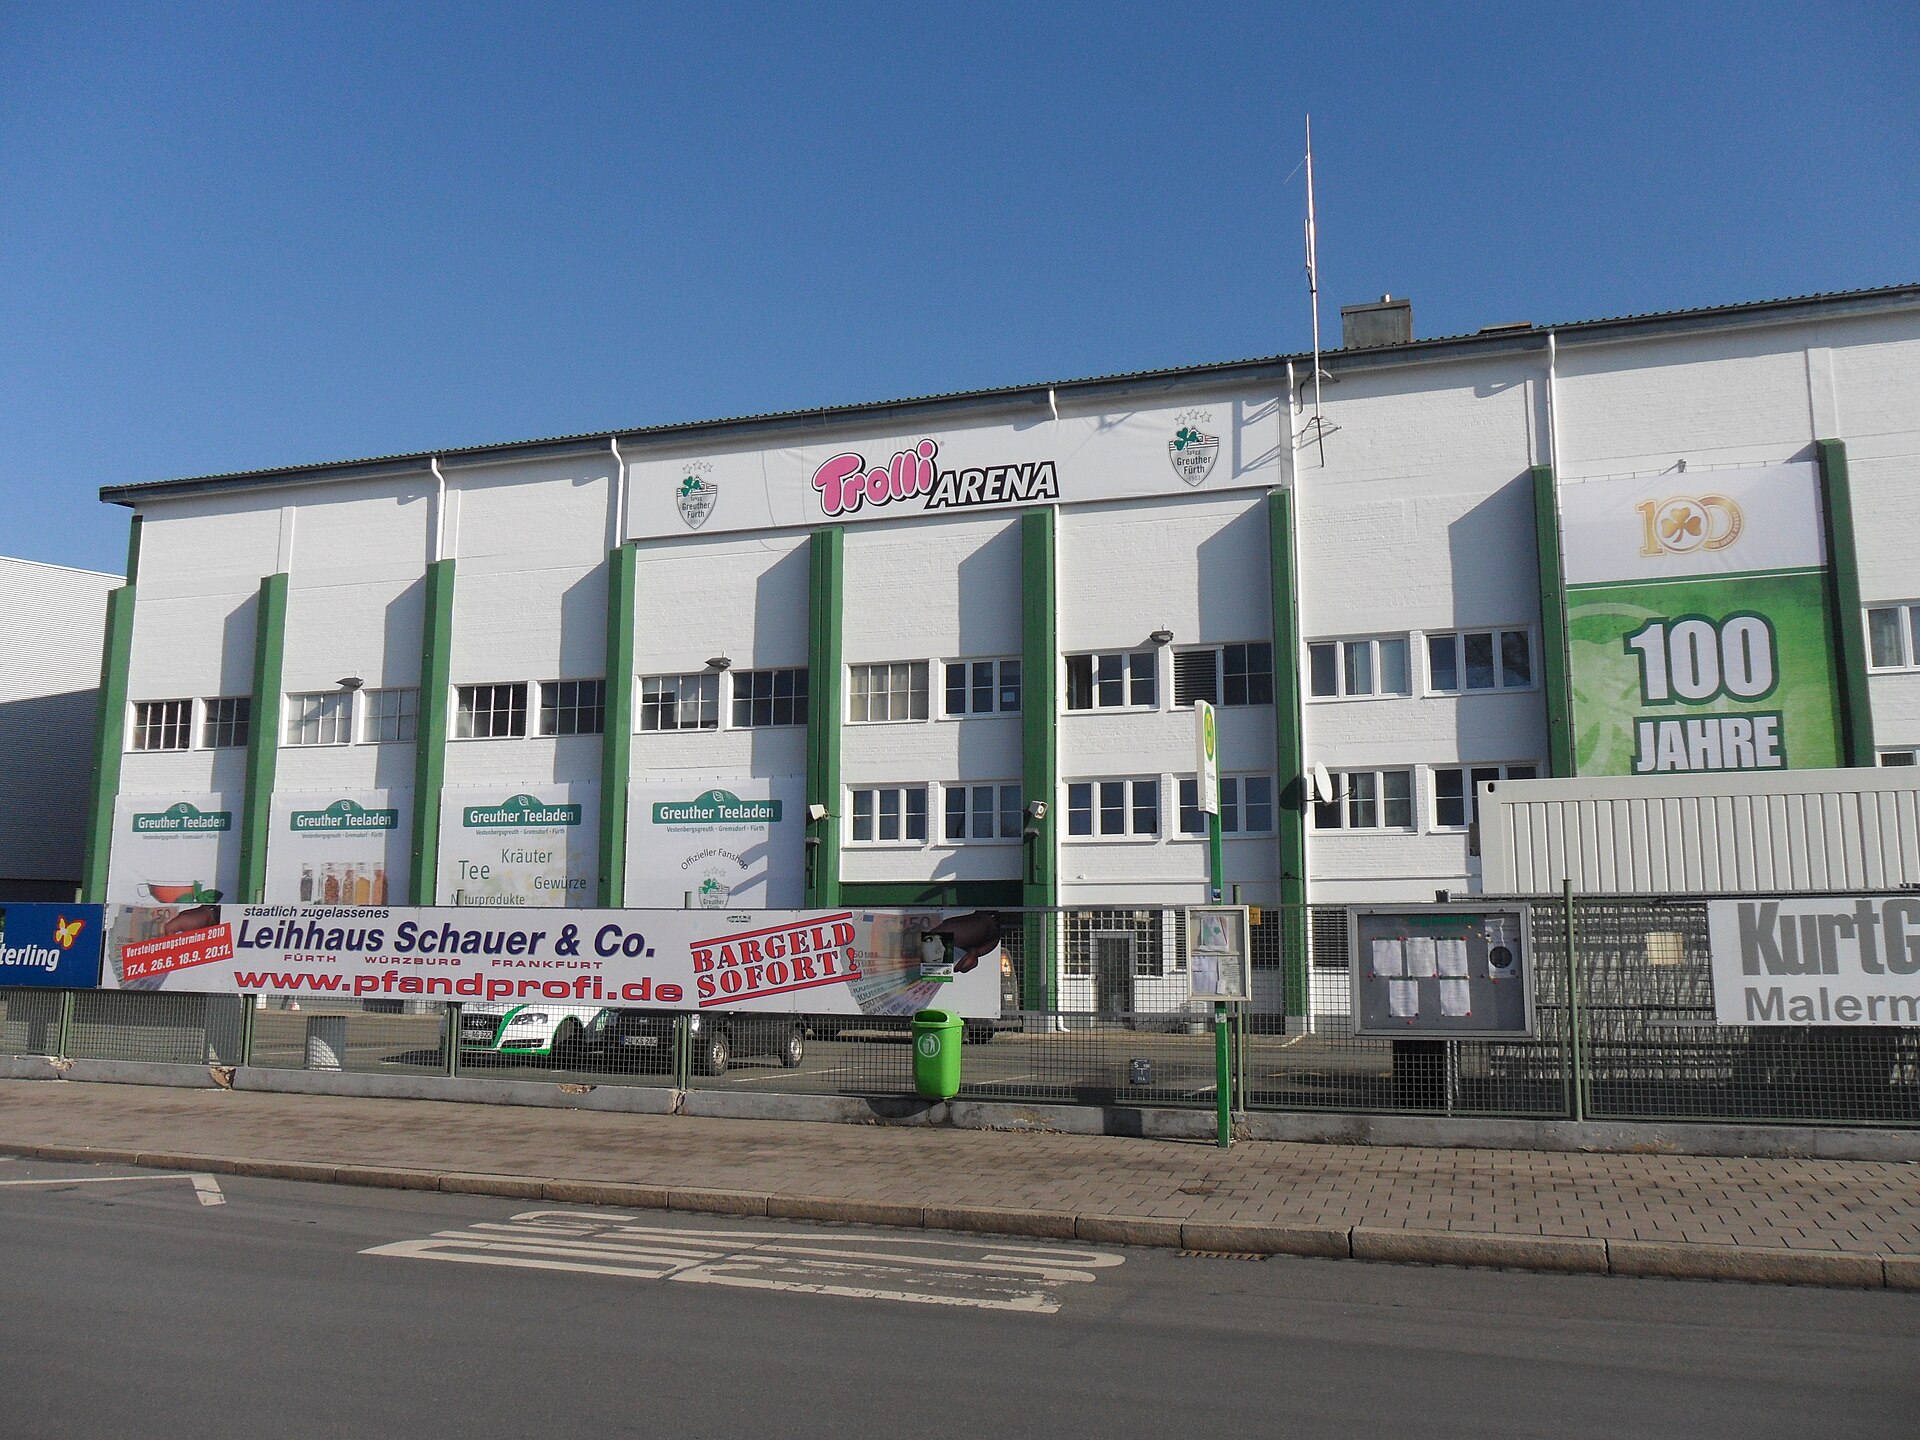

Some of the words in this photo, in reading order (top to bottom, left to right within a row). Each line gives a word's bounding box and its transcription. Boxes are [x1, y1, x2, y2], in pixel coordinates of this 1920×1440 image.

[1176, 456, 1212, 466] Greuther
[812, 439, 938, 517] Trolli
[924, 460, 1060, 510] ARENA
[1183, 466, 1205, 475] Fürth
[681, 502, 711, 511] Greuther
[687, 510, 705, 519] Fürth
[1629, 615, 1773, 701] 100
[1635, 715, 1782, 773] JAHRE
[296, 814, 342, 827] Greuther
[345, 813, 391, 826] Teeladen
[470, 809, 520, 823] Greuther
[523, 808, 573, 822] Teeladen
[660, 805, 714, 820] Greuther
[718, 804, 774, 819] Teeladen
[138, 816, 180, 829] Greuther
[182, 815, 225, 828] Teeladen
[501, 848, 553, 863] Kräuter
[681, 848, 717, 870] Offizieller
[718, 848, 749, 871] Fanshop
[458, 860, 490, 880] Tee
[534, 876, 587, 890] Gewürze
[450, 893, 526, 907] Nturprodukte
[243, 905, 297, 917] staatlich
[301, 907, 390, 920] zugelassenes
[126, 930, 206, 958] Versteigerungstermine
[207, 926, 226, 941] 2010
[236, 919, 385, 952] Leihhaus
[393, 921, 547, 956] Schauer
[554, 923, 581, 957] &
[593, 923, 656, 959] Co.
[690, 922, 856, 974] BARGELD
[126, 963, 148, 977] 17.4.
[150, 956, 175, 972] 26.6.
[178, 951, 201, 965] 18.9.
[204, 943, 231, 960] 20.11.
[283, 953, 337, 963] FÜRTH
[364, 955, 462, 966] WÜRZBURG
[491, 959, 604, 970] FRANKFURT
[234, 970, 684, 1002] www.pfandprofi.de
[1744, 986, 1920, 1022] Malerm
